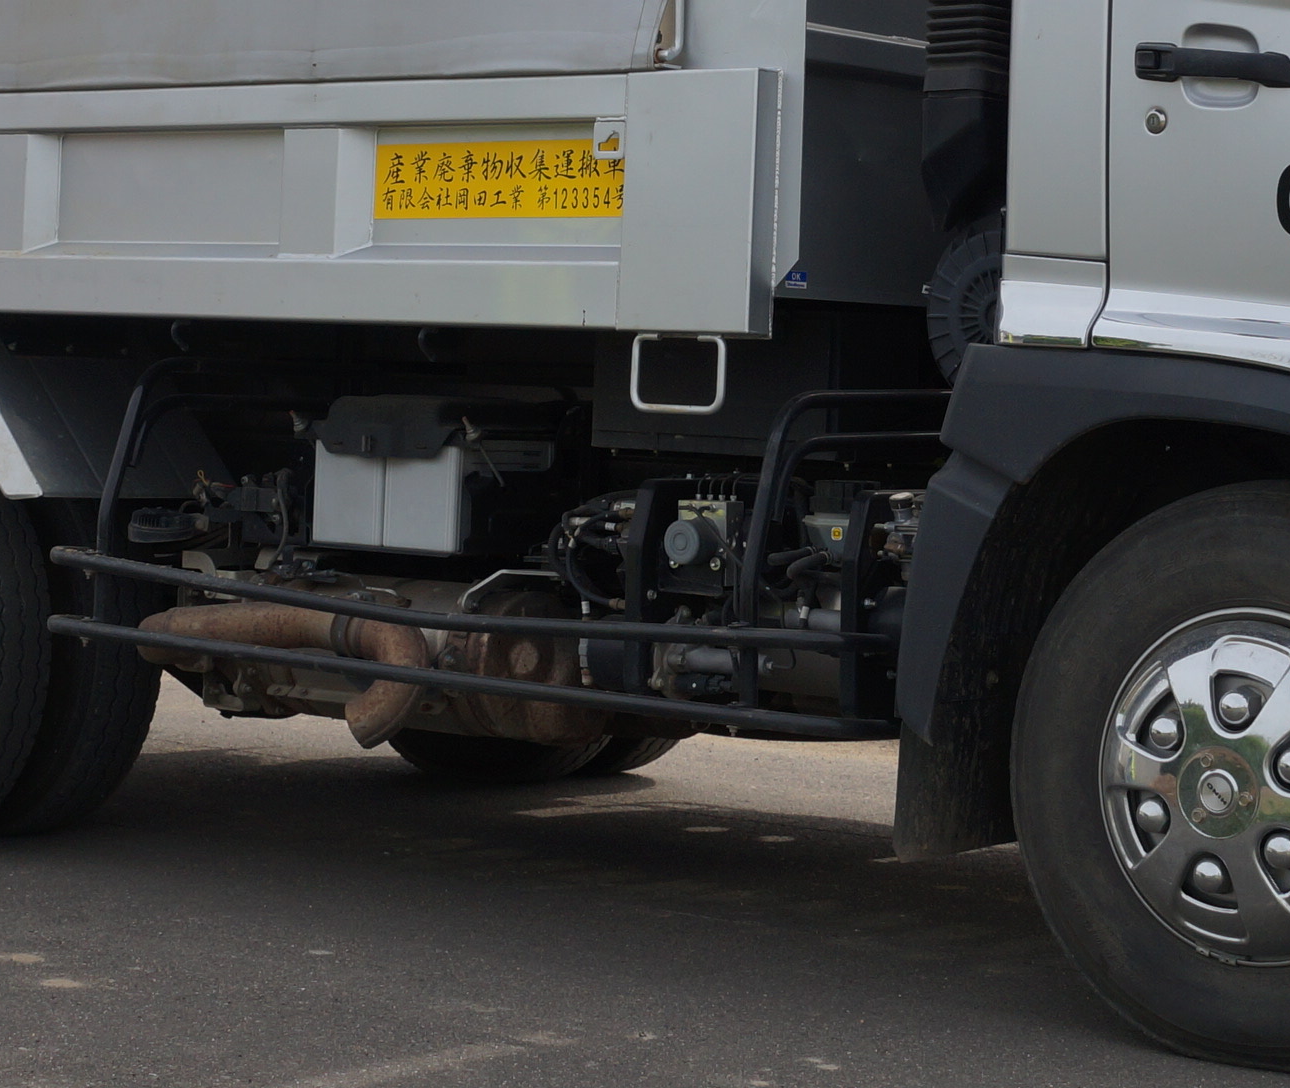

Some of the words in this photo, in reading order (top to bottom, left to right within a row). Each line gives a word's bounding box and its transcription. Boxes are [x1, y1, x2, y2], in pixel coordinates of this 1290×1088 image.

[382, 185, 525, 211] 有限会社岡田工業
[537, 185, 625, 211] 第123354号
[791, 272, 802, 281] OK
[1206, 782, 1228, 806] HINO
